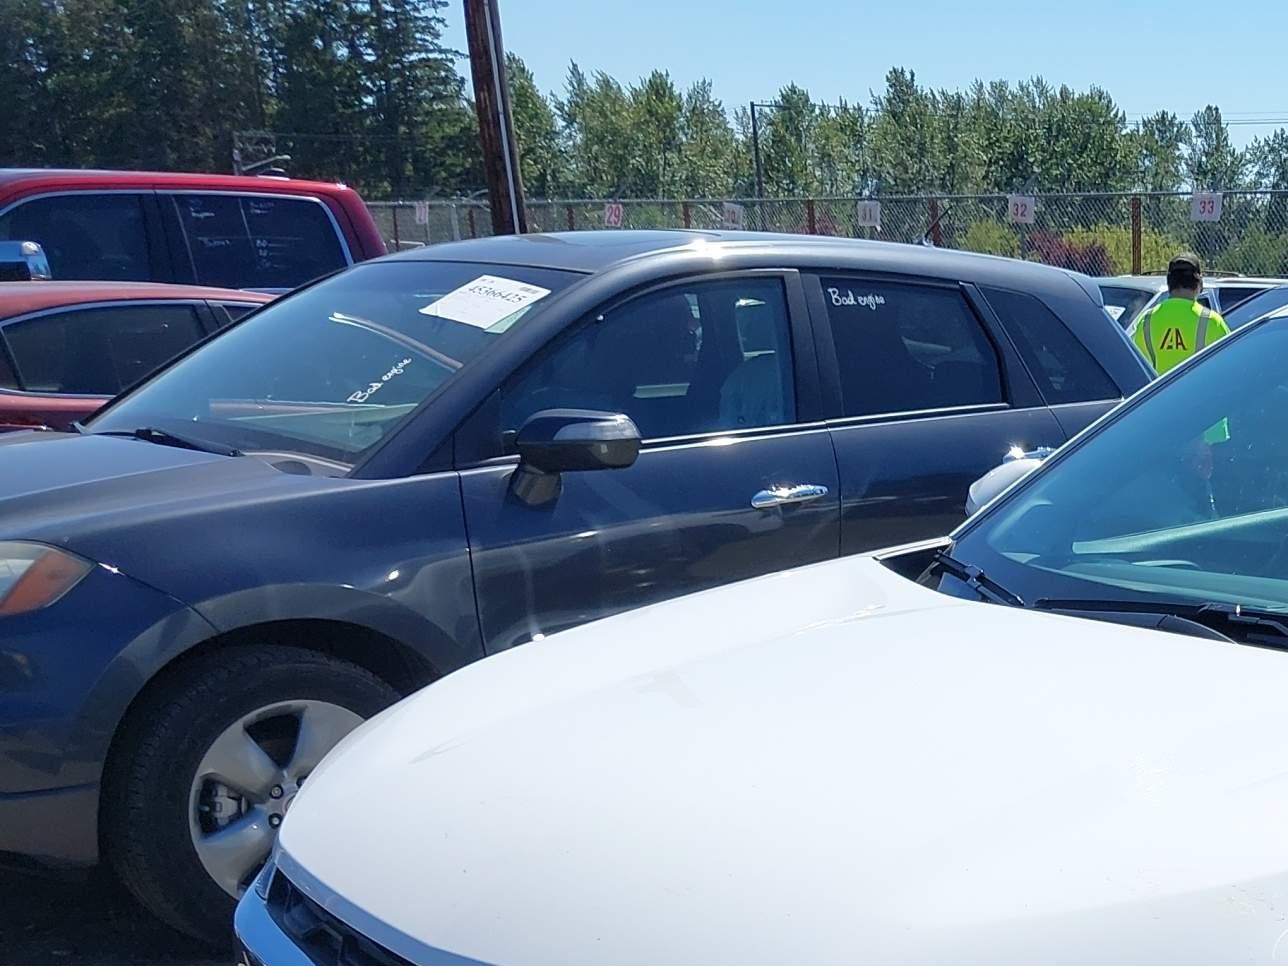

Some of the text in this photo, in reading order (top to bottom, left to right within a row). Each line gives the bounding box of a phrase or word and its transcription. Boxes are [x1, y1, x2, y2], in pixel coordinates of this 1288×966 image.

[607, 205, 621, 225] 29
[1012, 203, 1028, 218] 32
[1199, 200, 1215, 215] 33
[827, 287, 858, 306] Bad
[346, 382, 384, 402] Bad
